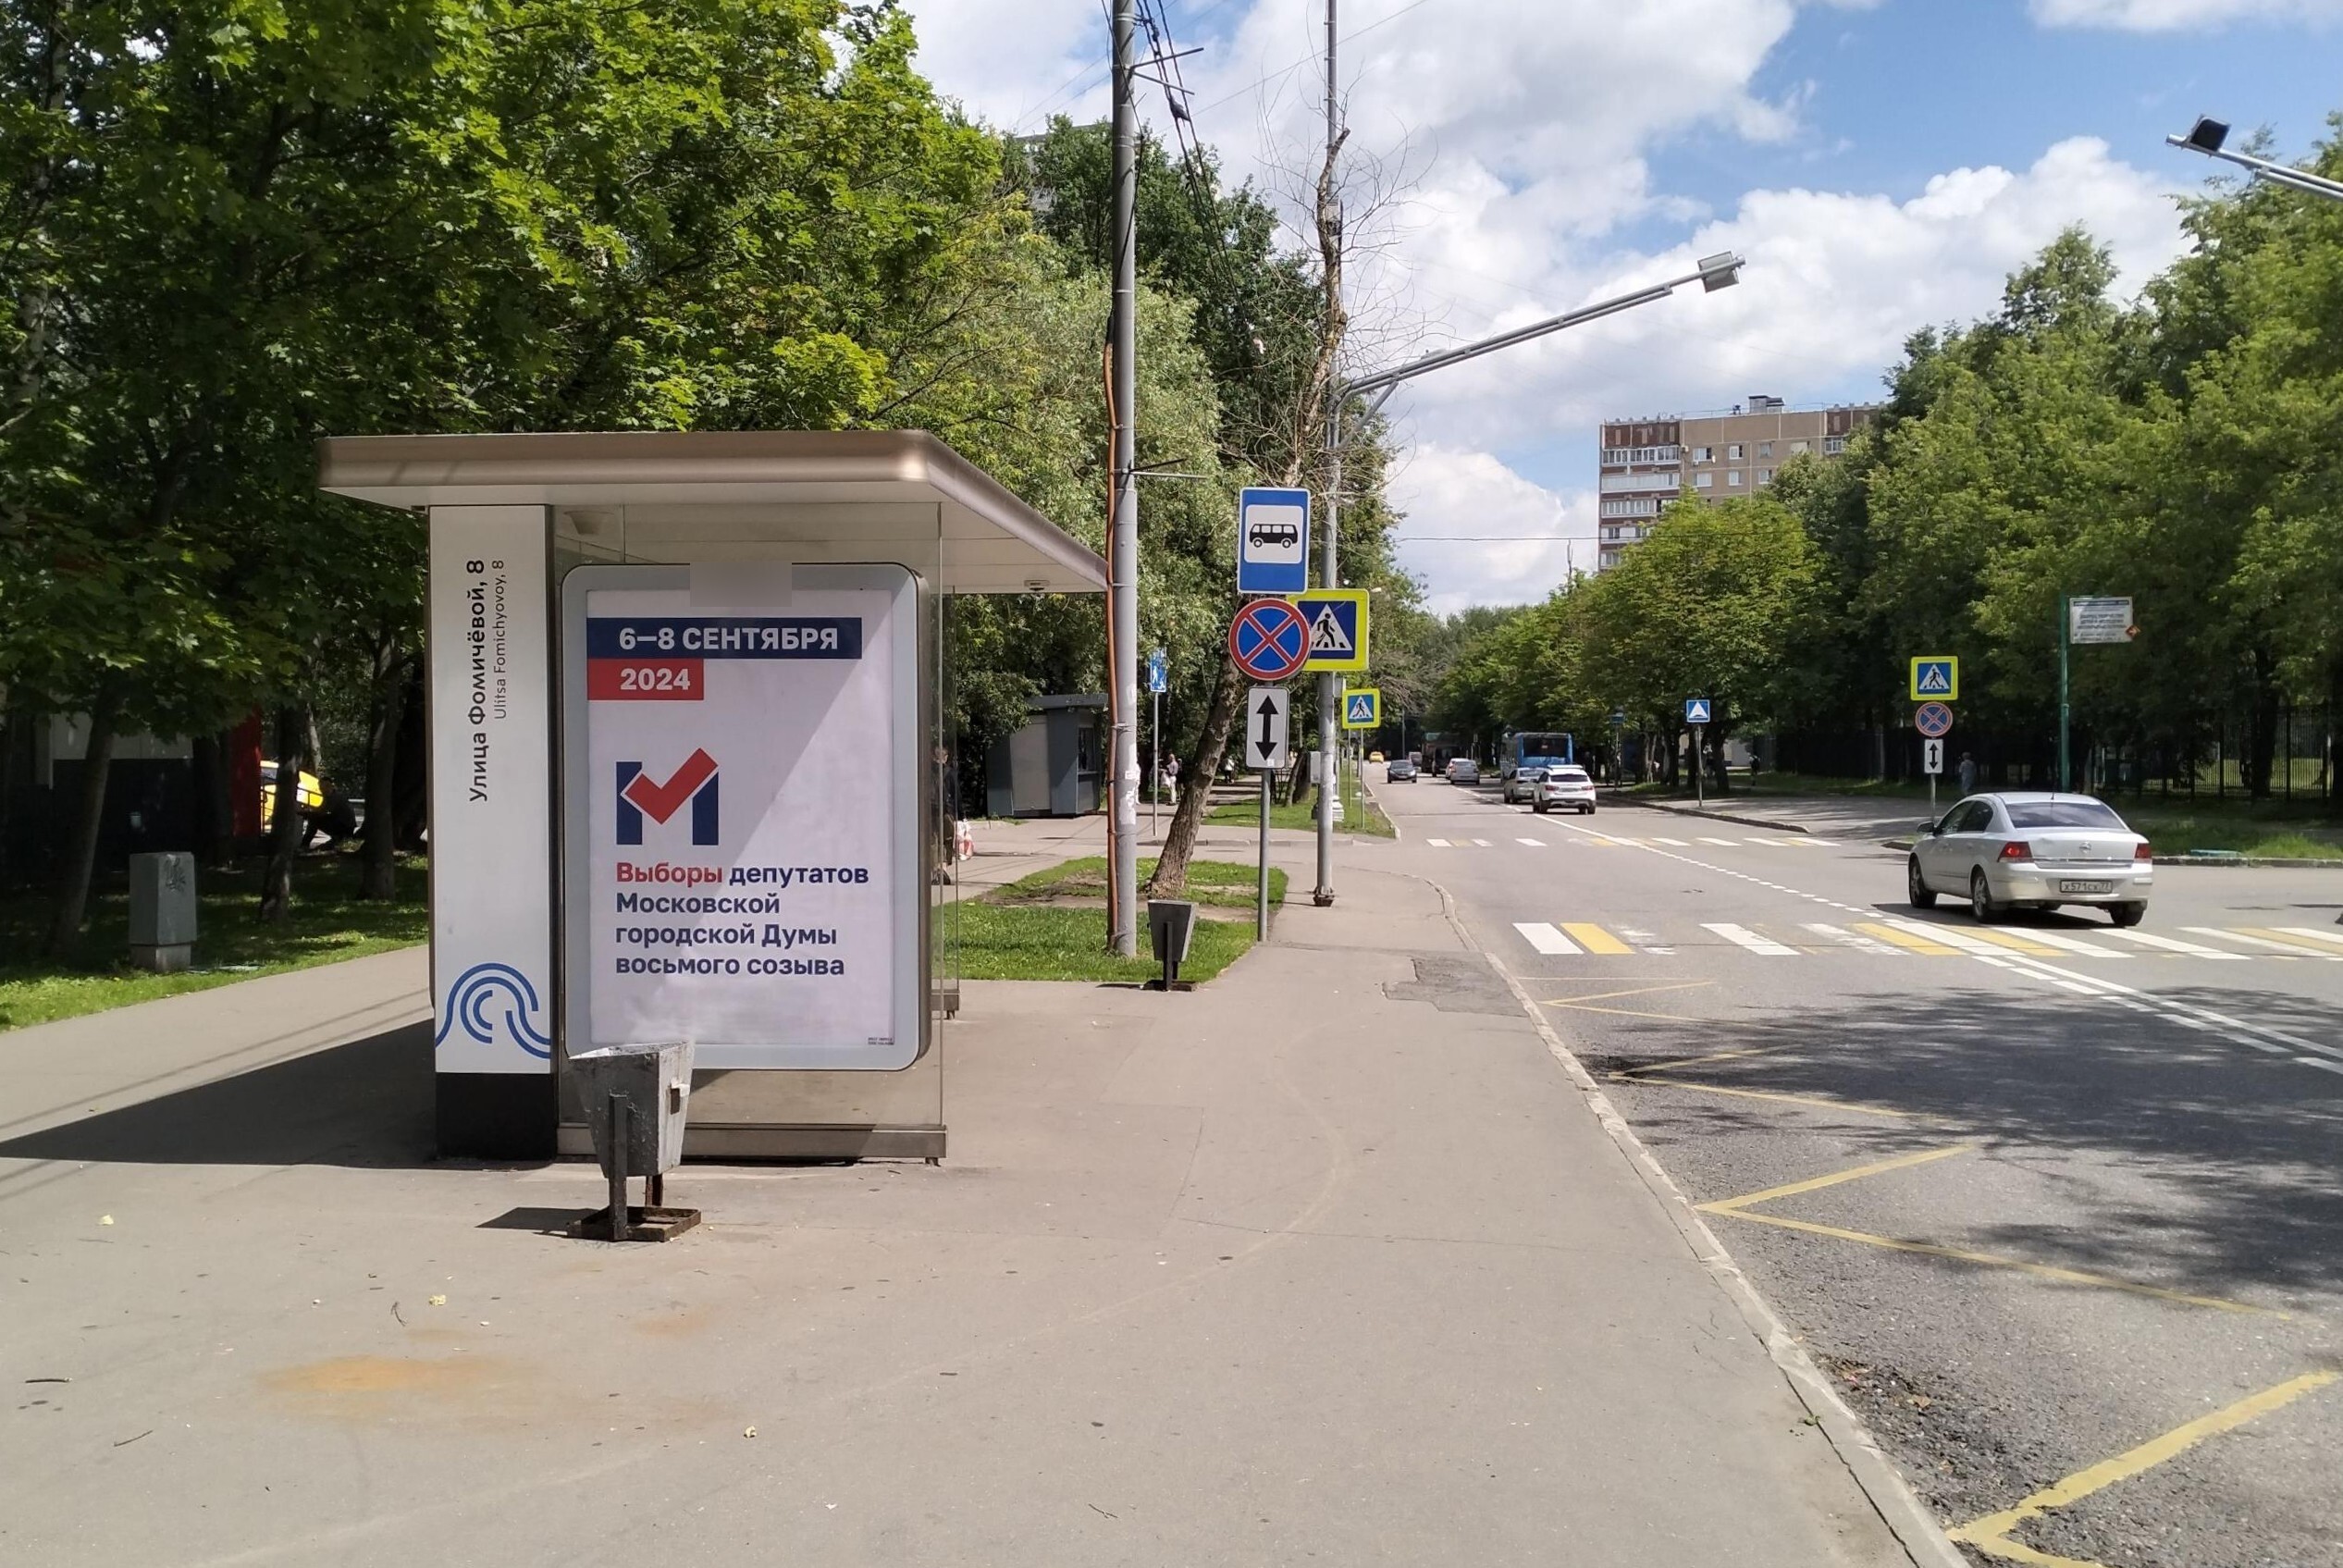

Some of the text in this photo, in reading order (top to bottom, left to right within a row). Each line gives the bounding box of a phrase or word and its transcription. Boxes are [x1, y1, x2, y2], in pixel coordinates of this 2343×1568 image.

[491, 560, 508, 720] Ulitsa Fomichyovoy, 8
[682, 627, 838, 649] СЕНТЯБРЯ
[466, 560, 489, 802] Улица Фомичёвой, 8
[620, 668, 691, 690] 2024
[616, 862, 869, 888] Выборы депутатов
[616, 892, 781, 914] Московской
[615, 922, 837, 949] городской Думы
[616, 957, 845, 976] восьмого созыва
